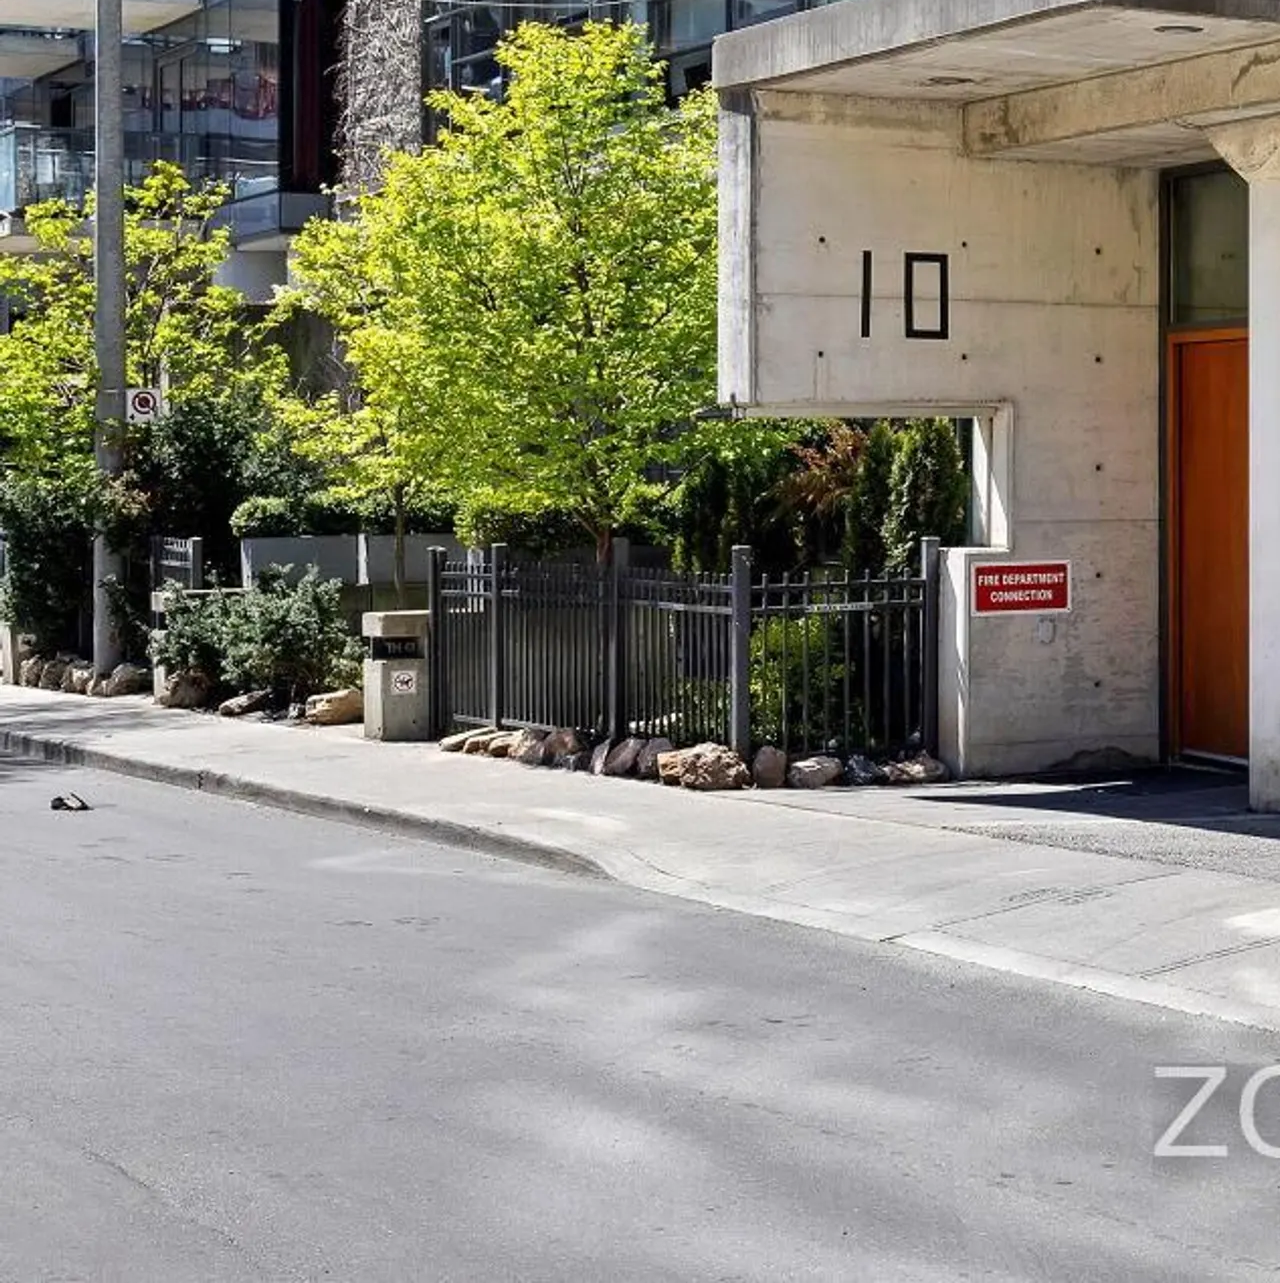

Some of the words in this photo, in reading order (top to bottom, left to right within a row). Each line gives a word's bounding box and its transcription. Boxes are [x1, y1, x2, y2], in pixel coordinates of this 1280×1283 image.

[861, 250, 949, 340] 10
[978, 575, 1000, 586] FIRE
[1002, 573, 1064, 585] DEPARTMENT
[990, 589, 1052, 603] CONNECTION
